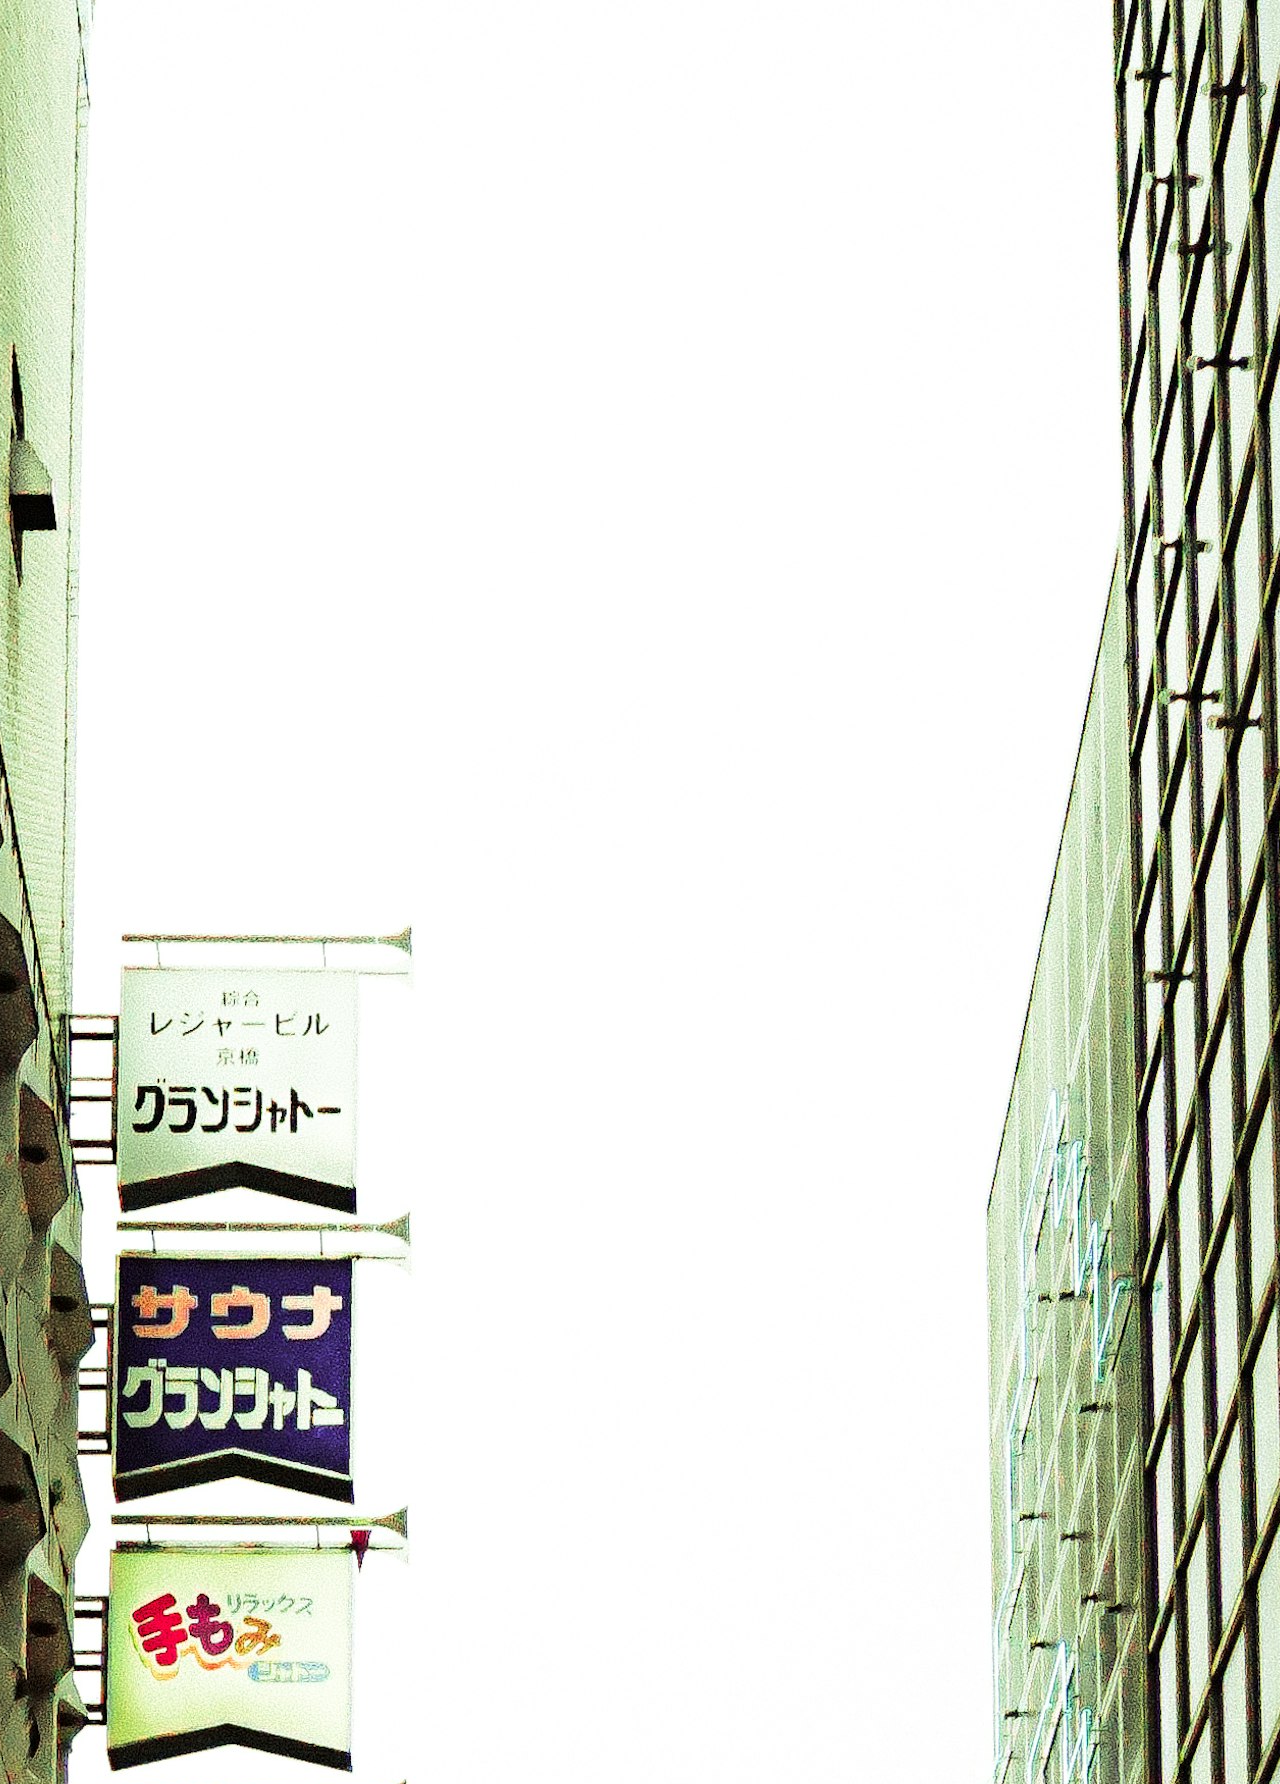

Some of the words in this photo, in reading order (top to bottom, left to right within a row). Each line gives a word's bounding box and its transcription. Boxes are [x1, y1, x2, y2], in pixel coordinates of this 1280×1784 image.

[150, 1010, 330, 1037] レジャービル
[216, 1046, 260, 1066] 京橋
[131, 1077, 342, 1134] グランシャトー
[131, 1284, 343, 1341] サウナ
[122, 1357, 345, 1431] グランシャトー
[131, 1592, 283, 1667] 手もみ
[227, 1592, 314, 1616] リラックス
